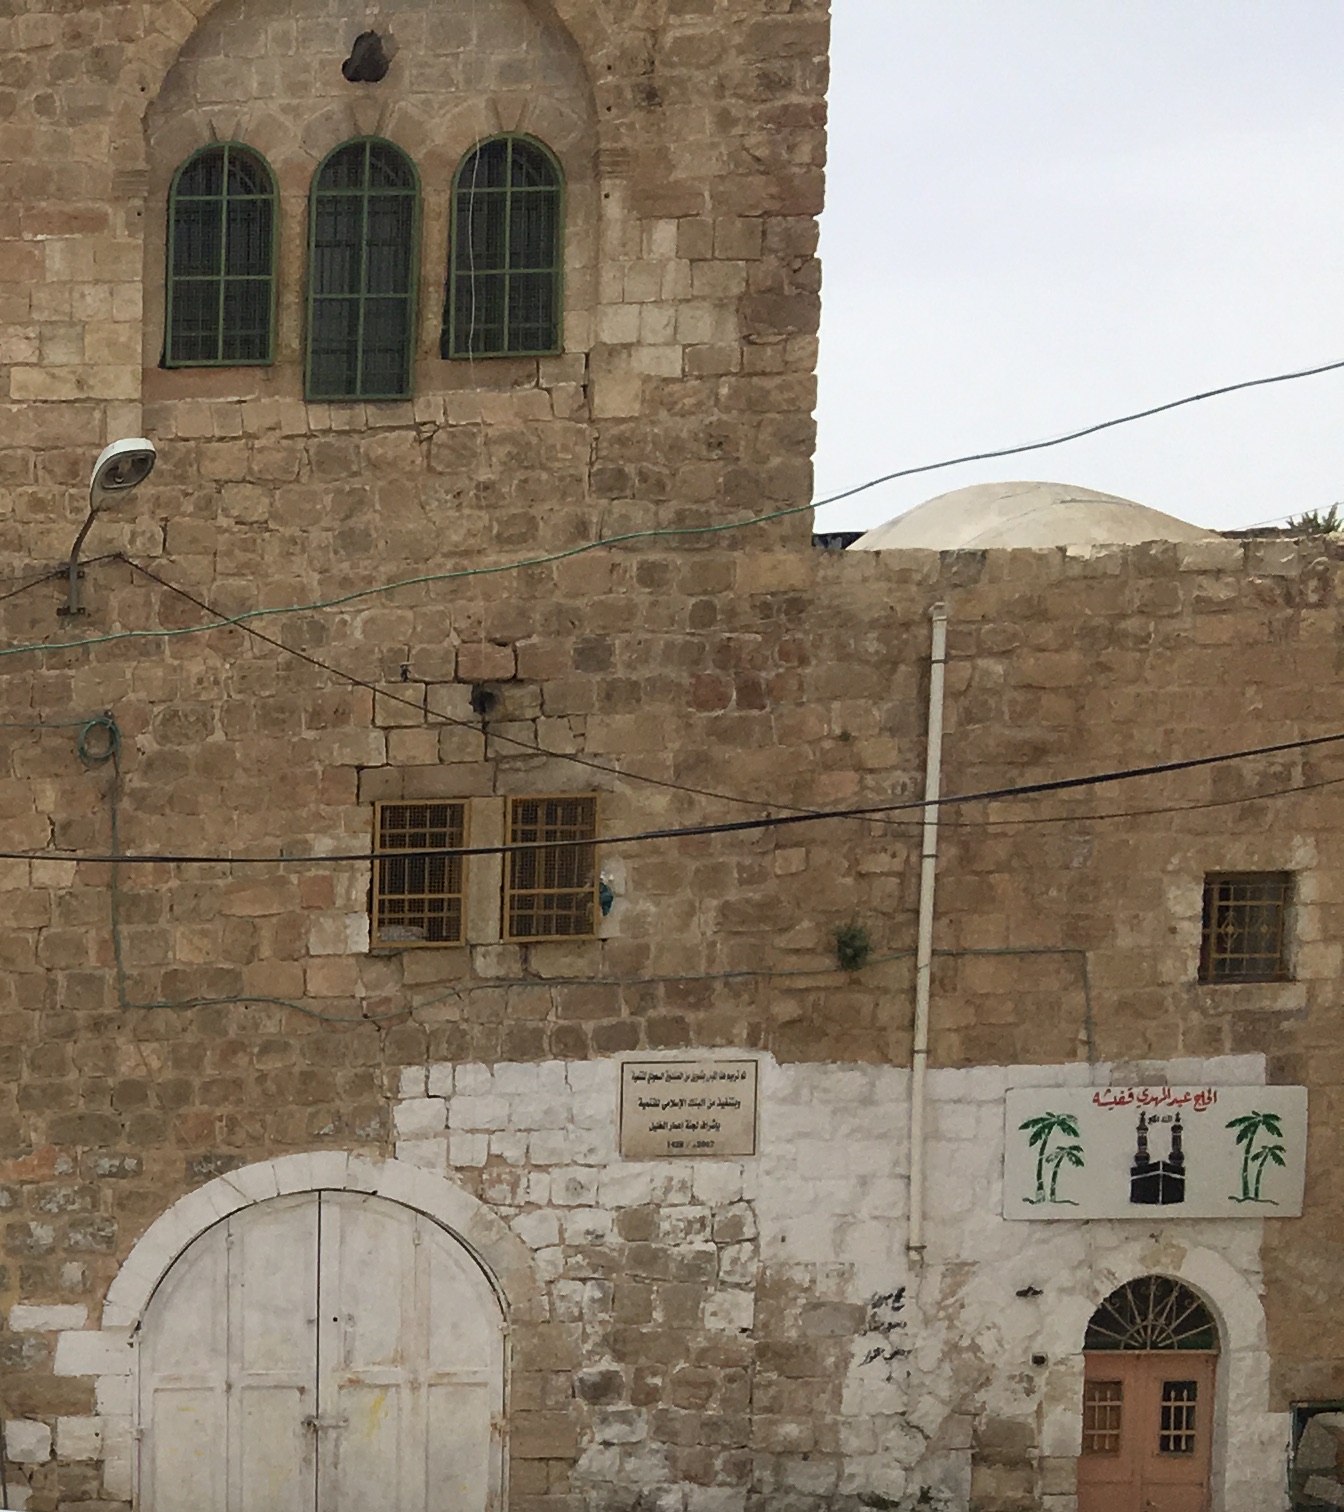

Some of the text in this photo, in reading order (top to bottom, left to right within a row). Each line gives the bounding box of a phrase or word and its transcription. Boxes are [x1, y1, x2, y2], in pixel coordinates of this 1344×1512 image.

[1136, 1087, 1171, 1109] المهدي
[1167, 1091, 1192, 1107] عبد
[1193, 1088, 1217, 1112] الحاج
